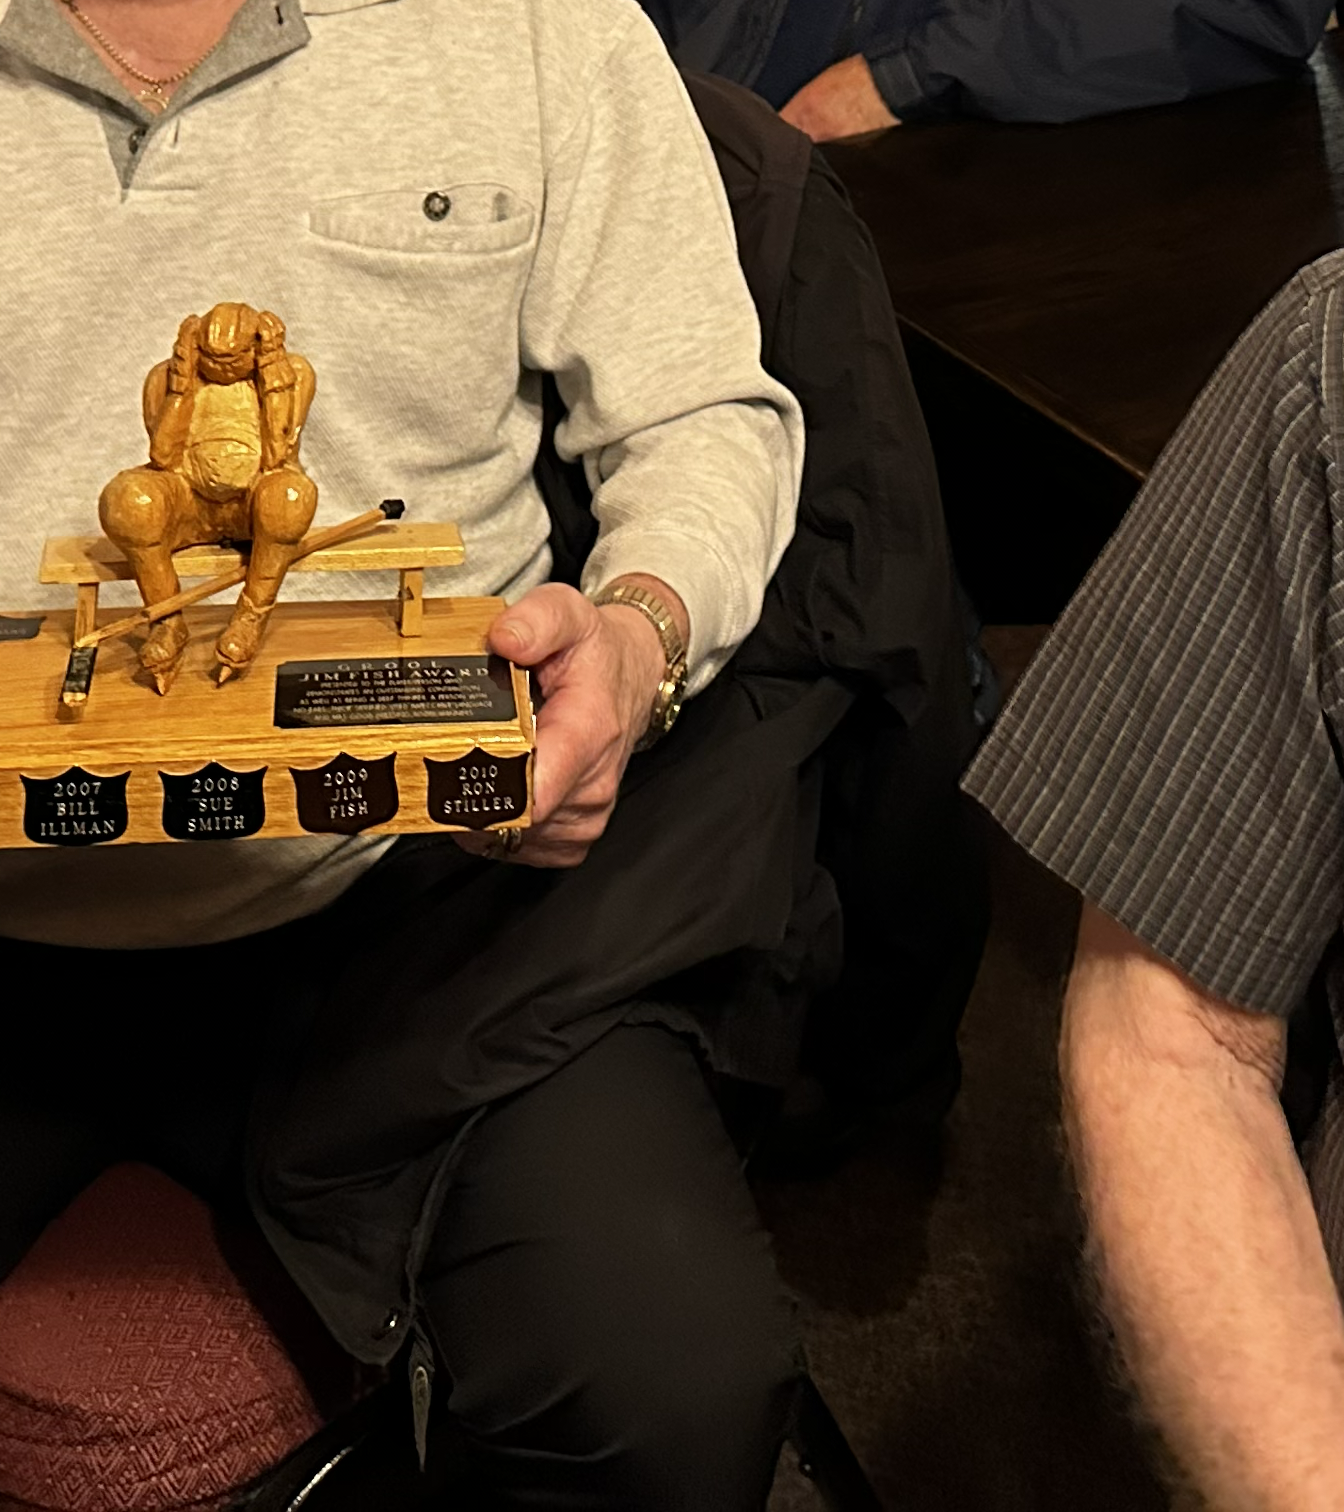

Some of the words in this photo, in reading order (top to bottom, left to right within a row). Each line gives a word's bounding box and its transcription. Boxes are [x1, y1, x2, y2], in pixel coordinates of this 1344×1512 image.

[298, 672, 340, 683] JIM
[349, 669, 401, 681] FISH
[410, 665, 490, 679] AWARD
[322, 767, 369, 787] 2009
[458, 764, 498, 781] 2010
[53, 781, 103, 798] 2007
[190, 776, 240, 794] 2008
[461, 781, 496, 796] RON
[330, 786, 363, 803] JIM
[56, 800, 100, 816] BILL
[198, 796, 234, 812] SUE
[329, 800, 369, 819] FISH
[443, 796, 515, 815] STILLER
[40, 819, 116, 837] ILLMAN
[187, 814, 246, 833] SMITH
